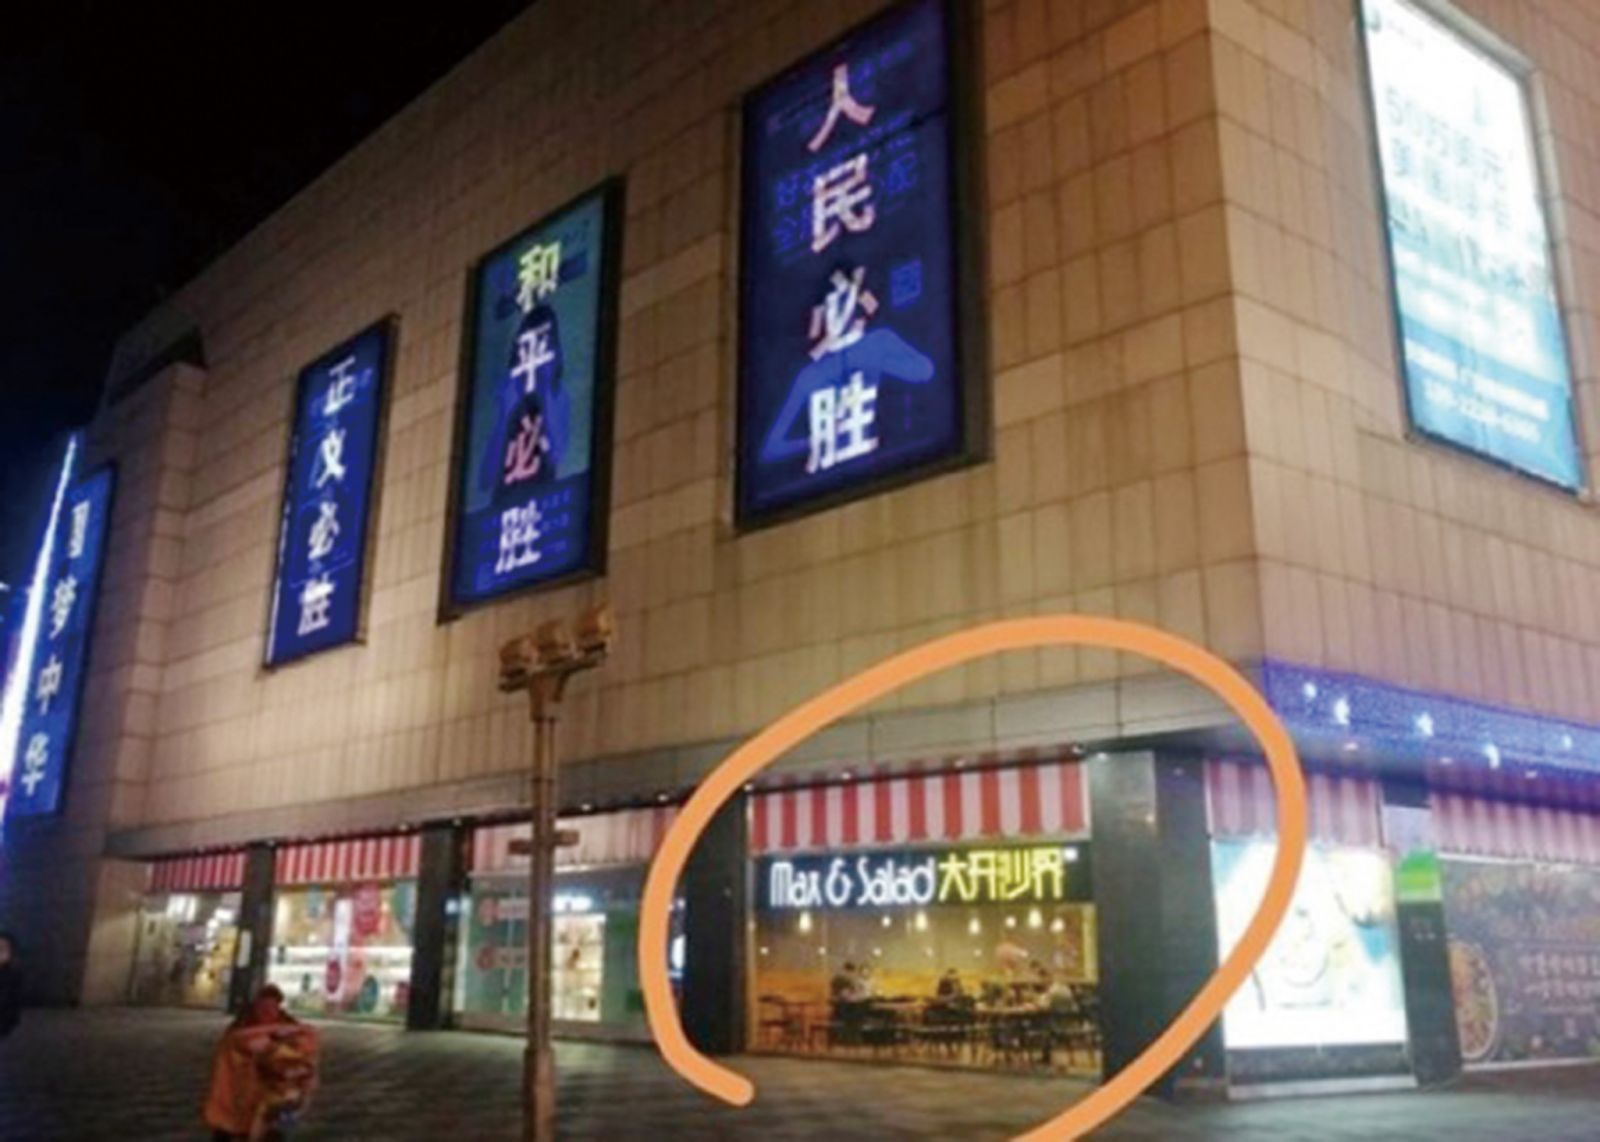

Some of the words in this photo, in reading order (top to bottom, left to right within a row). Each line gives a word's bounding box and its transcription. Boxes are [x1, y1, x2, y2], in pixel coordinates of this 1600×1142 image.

[495, 240, 562, 575] 和平必胜
[804, 62, 880, 475] 人民必胜
[297, 356, 356, 636] 正义必胜
[770, 861, 822, 907] Max
[856, 856, 936, 905] Salad
